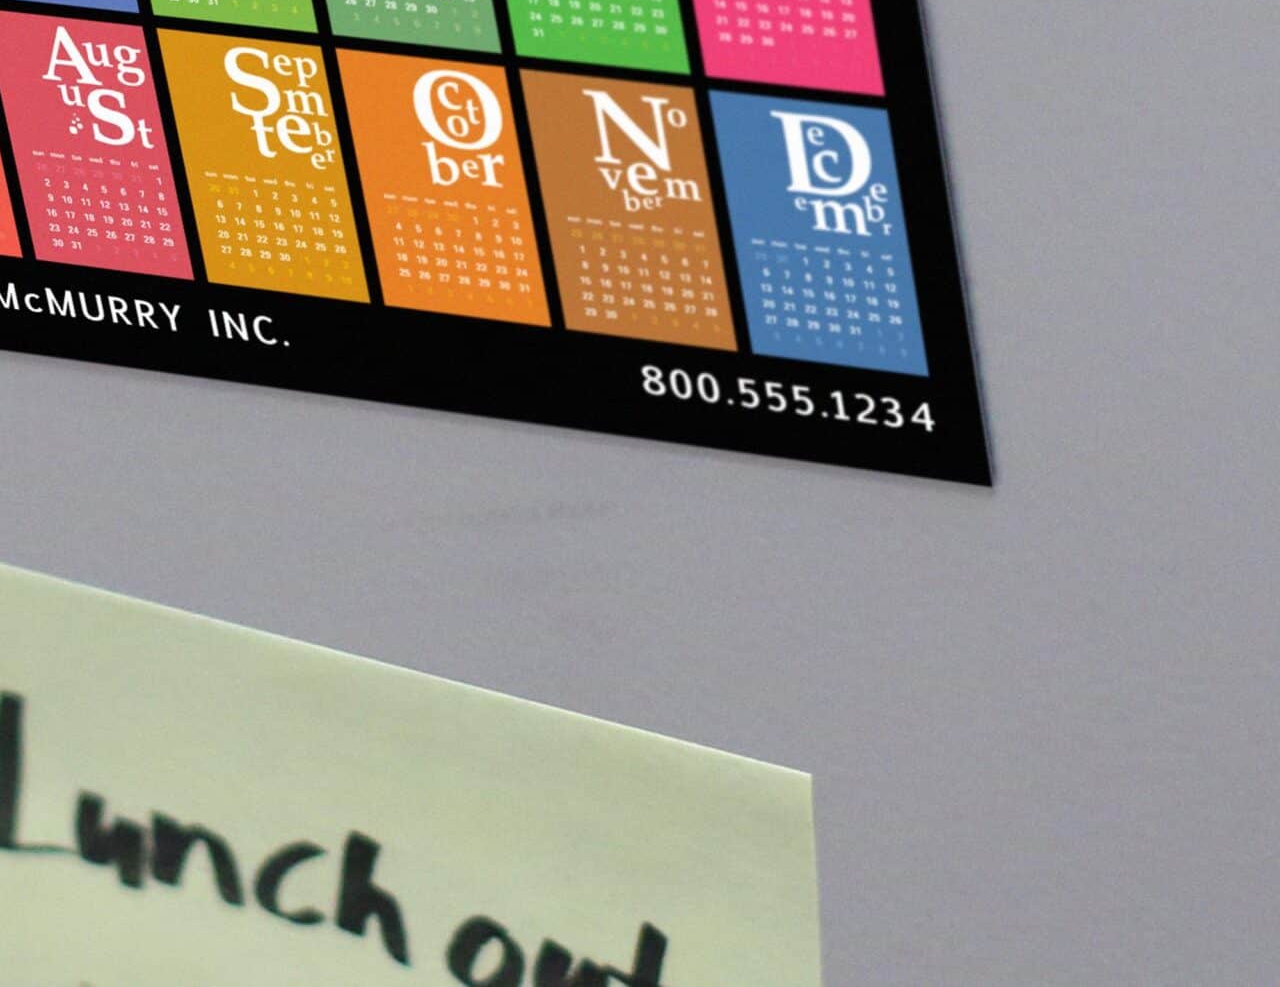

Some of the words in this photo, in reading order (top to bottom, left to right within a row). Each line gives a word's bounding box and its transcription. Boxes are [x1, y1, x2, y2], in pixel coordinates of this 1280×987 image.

[43, 177, 52, 188] 2
[63, 180, 71, 190] 3
[82, 182, 89, 192] 4
[100, 184, 108, 195] 5
[119, 187, 128, 197] 6
[138, 189, 145, 199] 7
[157, 191, 166, 202] 8
[155, 176, 163, 186] 1
[252, 188, 259, 198] 1
[271, 191, 280, 201] 2
[291, 193, 299, 203] 3
[311, 196, 319, 205] 4
[329, 198, 338, 209] 5
[216, 199, 225, 210] 6
[235, 201, 243, 211] 7
[255, 204, 263, 214] 8
[274, 206, 283, 216] 9
[289, 208, 302, 219] 10
[308, 210, 321, 221] 11
[328, 212, 341, 224] 12
[207, 308, 292, 347] INC.
[640, 364, 936, 433] 800.555.1234
